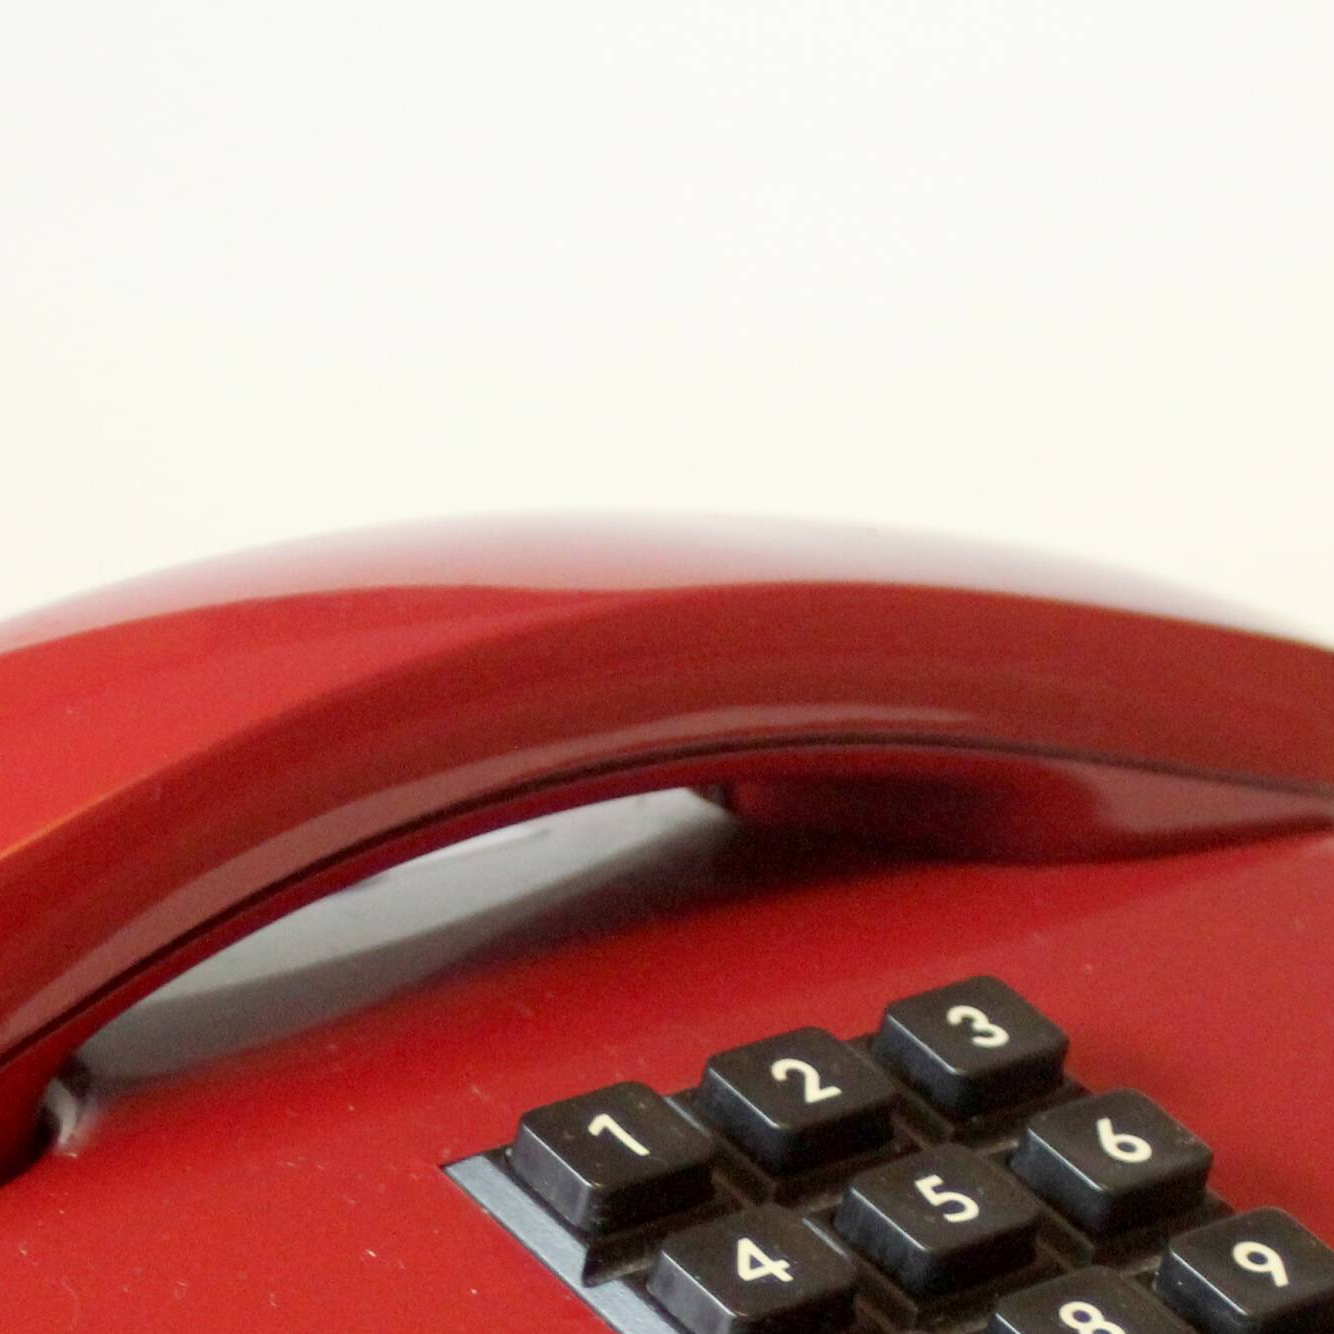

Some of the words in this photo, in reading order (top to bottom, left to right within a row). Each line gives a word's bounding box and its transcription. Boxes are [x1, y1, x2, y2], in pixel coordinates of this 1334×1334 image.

[946, 1004, 1011, 1048] 3
[770, 1057, 843, 1104] 2
[587, 1112, 651, 1157] 1
[1095, 1116, 1154, 1164] 6
[914, 1173, 981, 1224] 5
[736, 1236, 795, 1283] 4
[1231, 1240, 1290, 1288] 9
